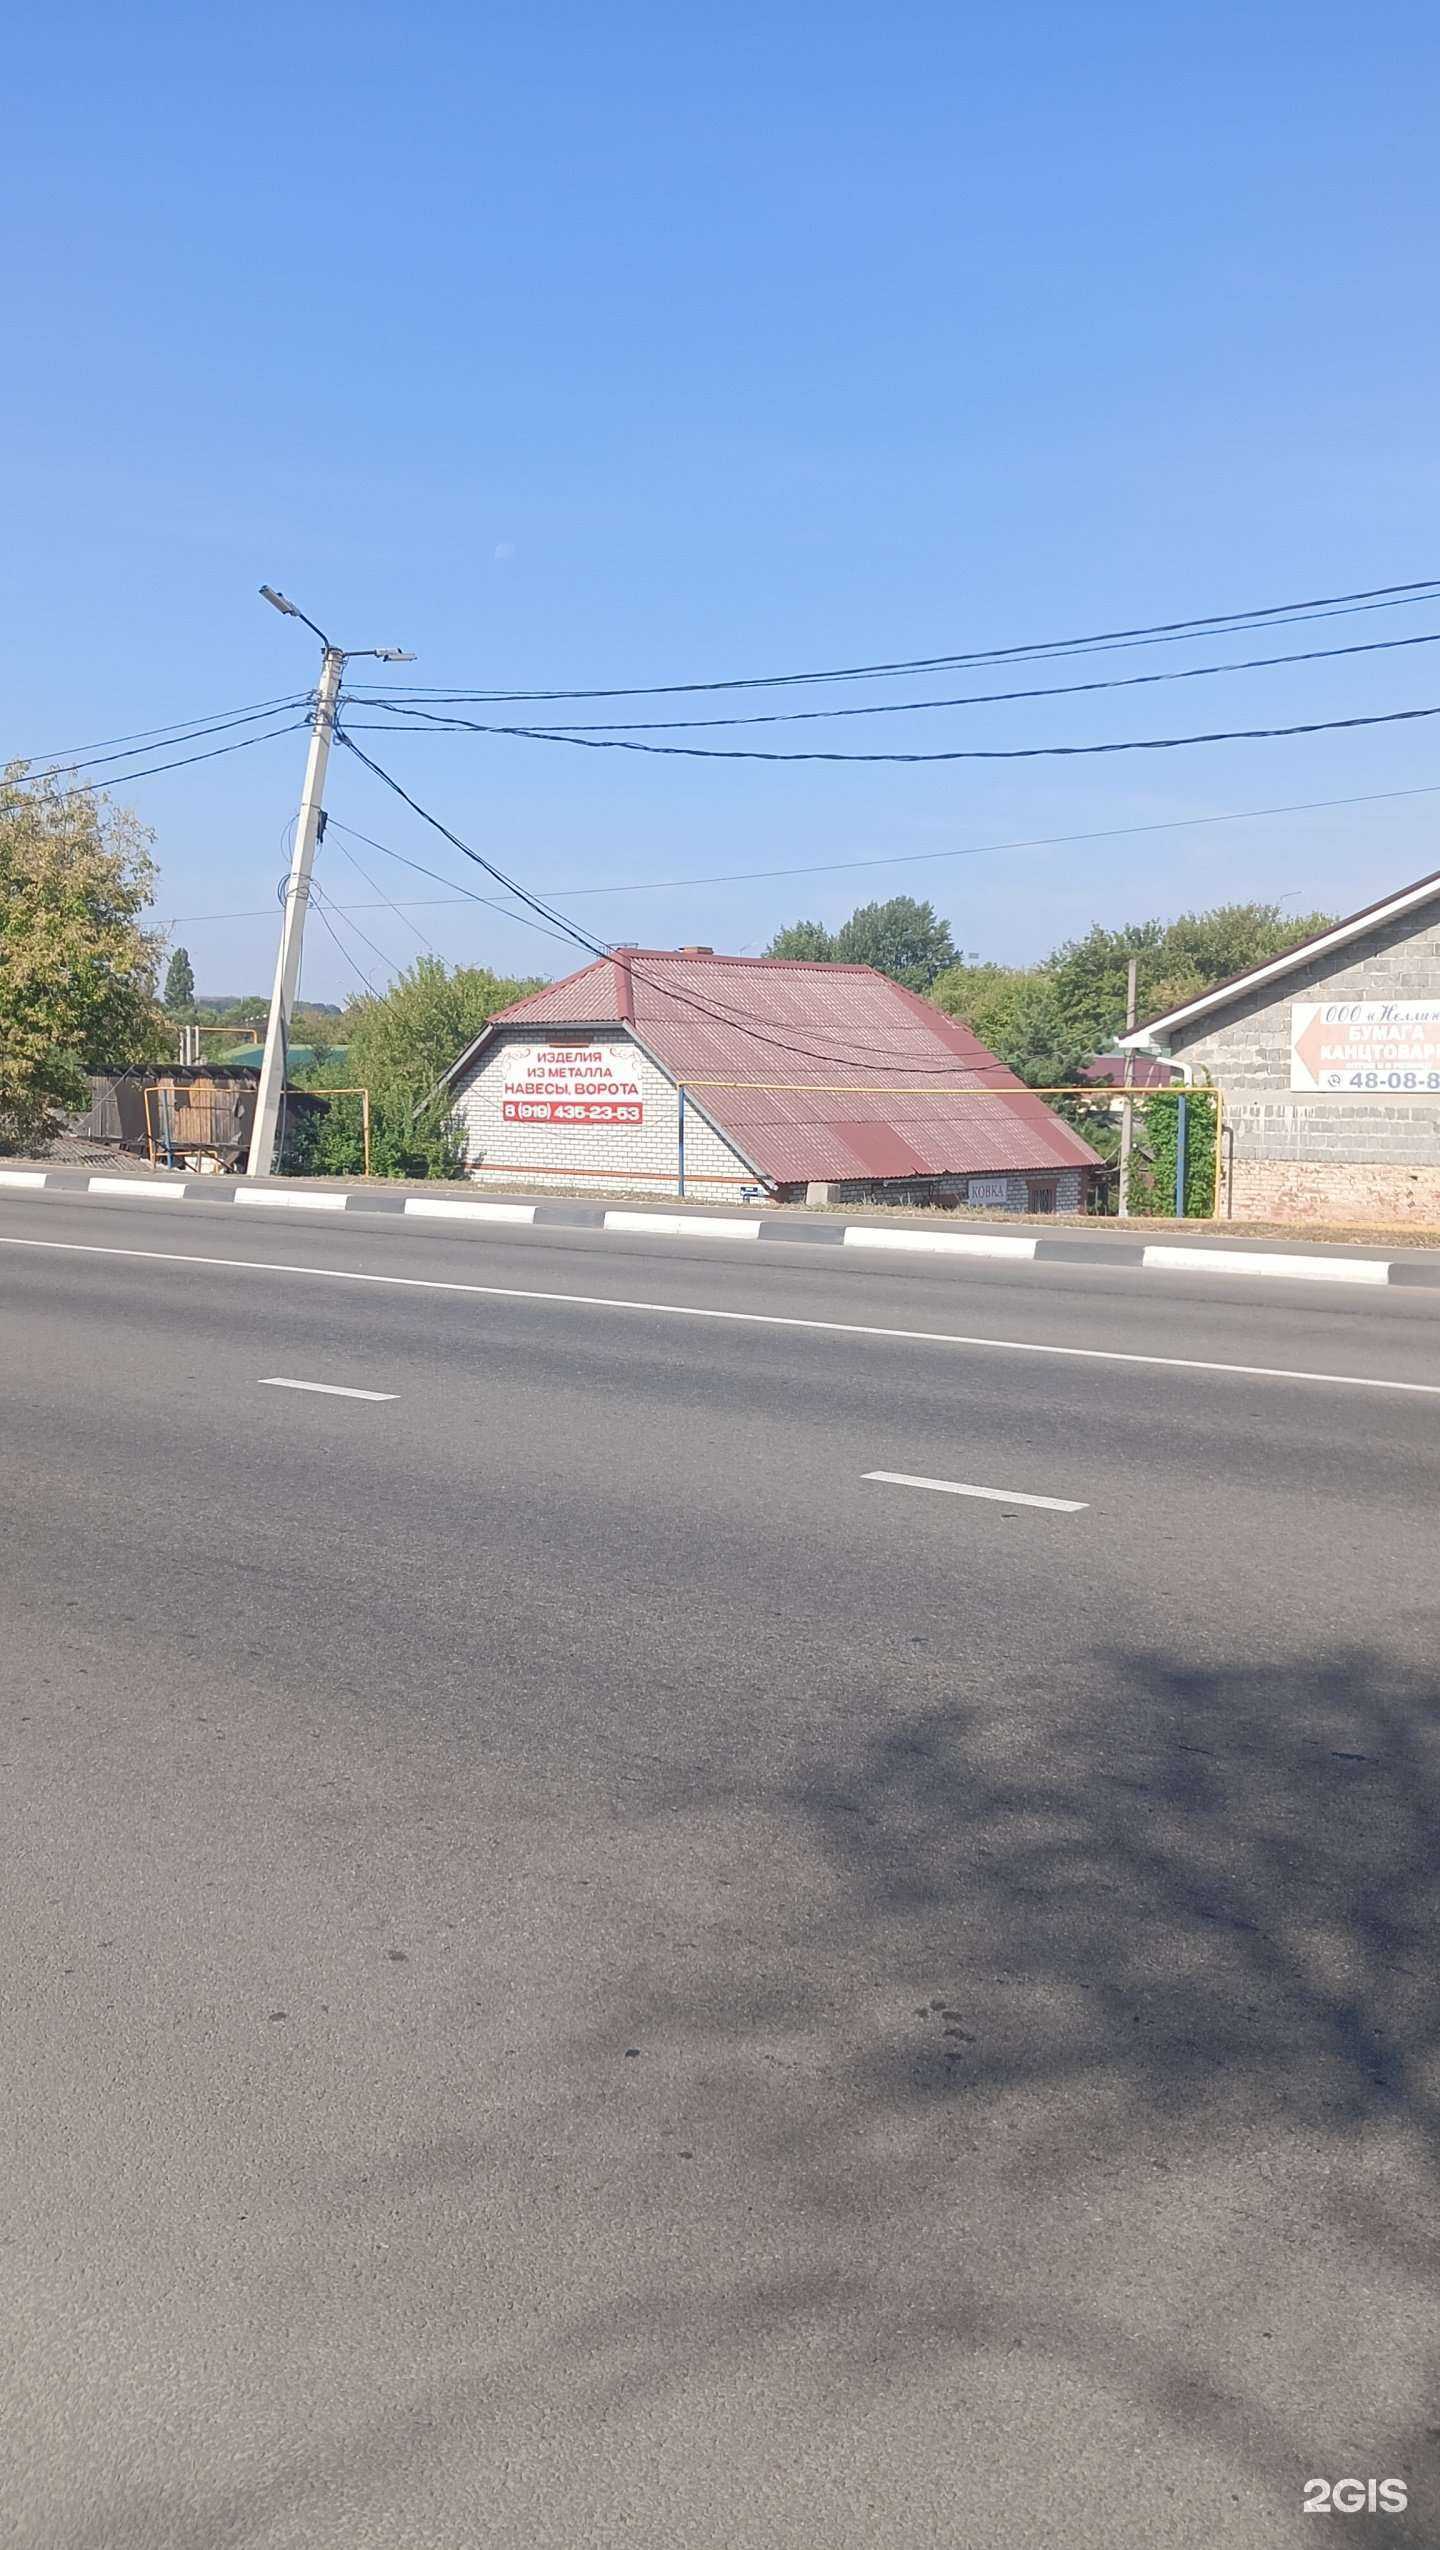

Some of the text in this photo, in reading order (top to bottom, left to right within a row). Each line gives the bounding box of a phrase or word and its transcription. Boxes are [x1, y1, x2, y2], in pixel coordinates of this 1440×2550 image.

[1326, 1005, 1361, 1022] ООО
[1348, 1024, 1424, 1041] БУМАГА
[537, 1052, 603, 1063] ИЗДЕЛИЯ
[527, 1067, 613, 1078] ИЗ МЕТАЛЛА
[504, 1082, 639, 1096] НАВЕСЫ, ВОРОТА
[504, 1104, 516, 1118] 8
[553, 1105, 640, 1121] 435-23-53
[972, 1184, 1006, 1198] КОВКА
